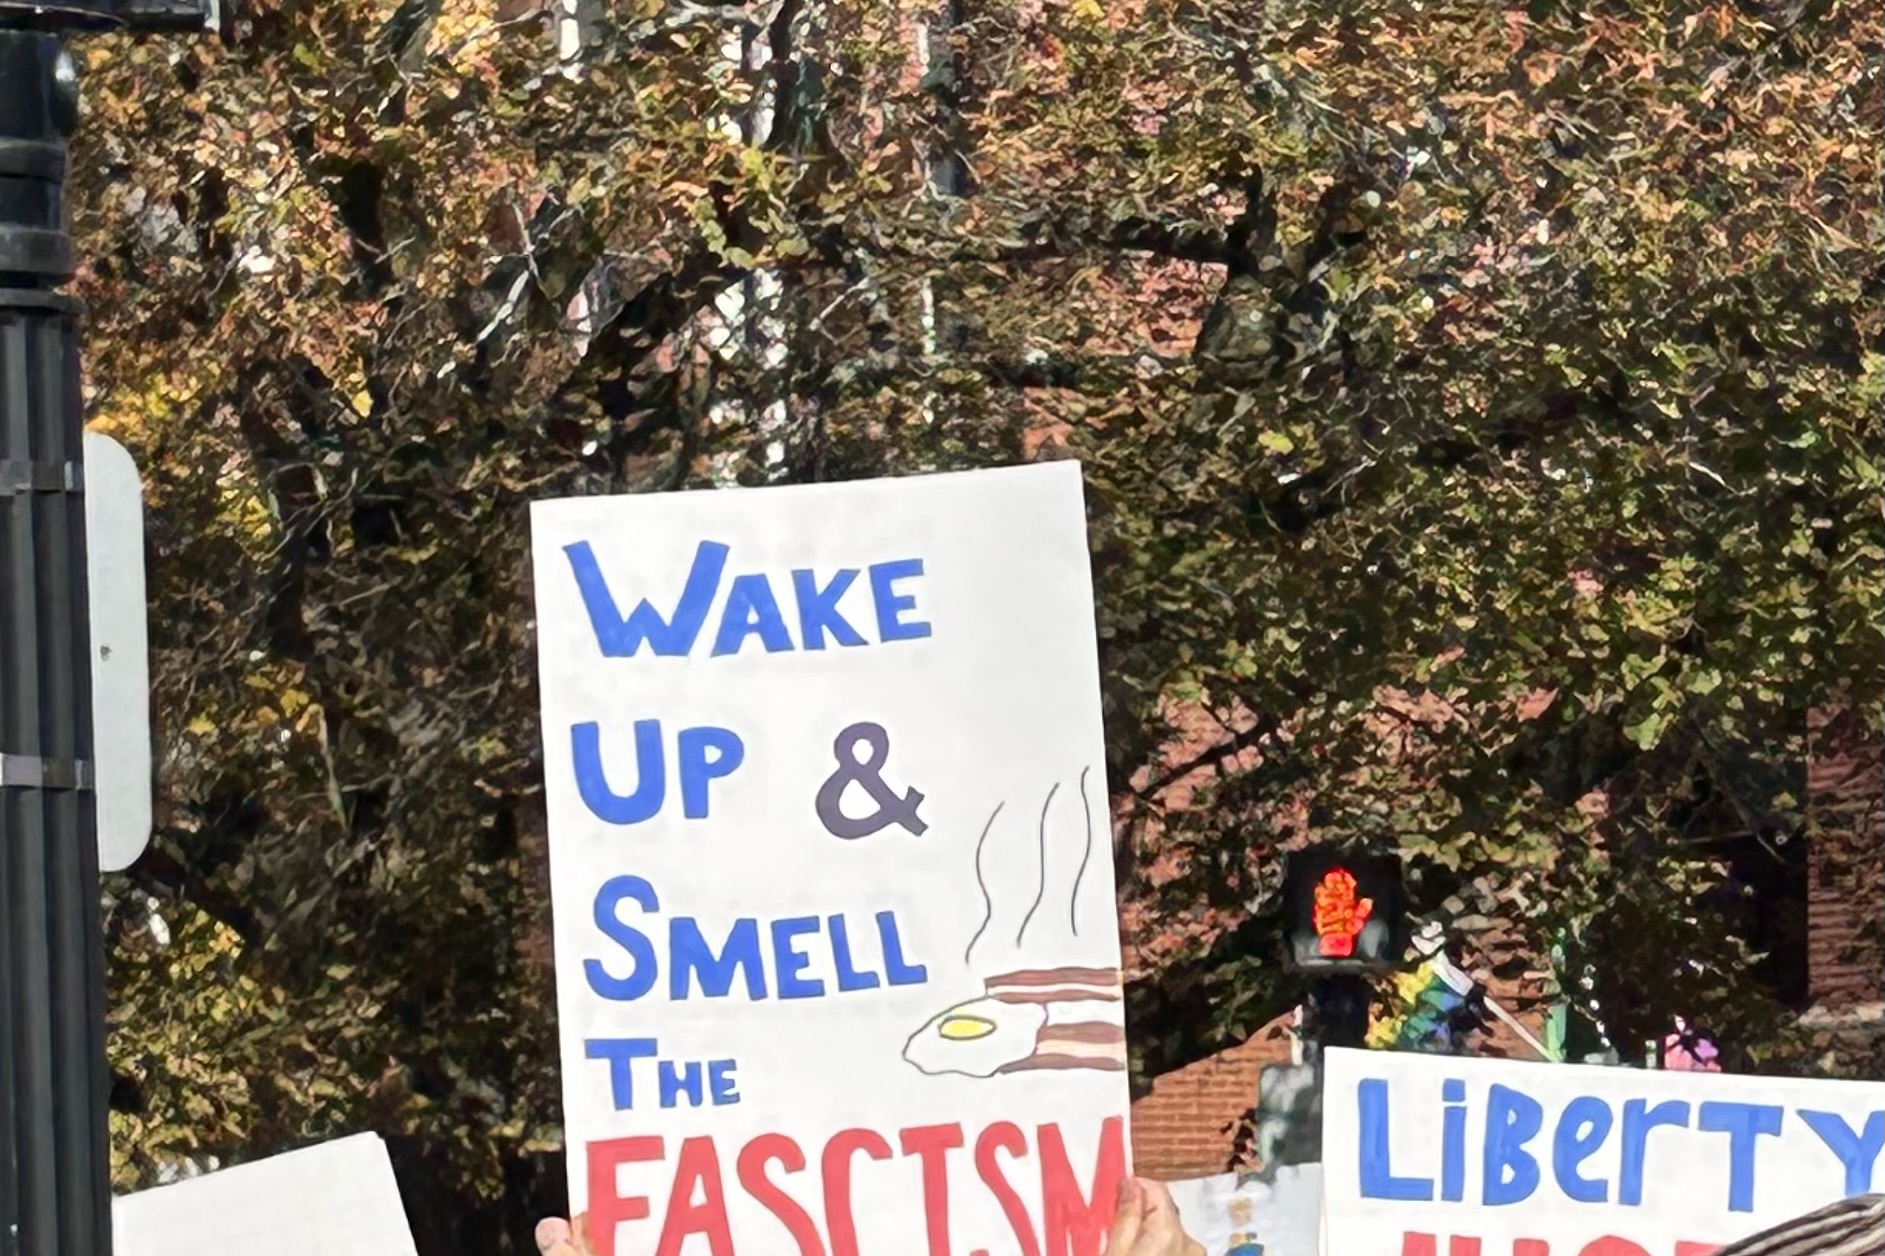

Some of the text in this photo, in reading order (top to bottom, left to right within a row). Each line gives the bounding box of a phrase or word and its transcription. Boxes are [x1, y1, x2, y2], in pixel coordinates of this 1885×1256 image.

[562, 540, 931, 657] WAKE
[571, 719, 929, 840] UP &
[583, 874, 929, 1003] SMELL
[584, 1037, 741, 1110] THE
